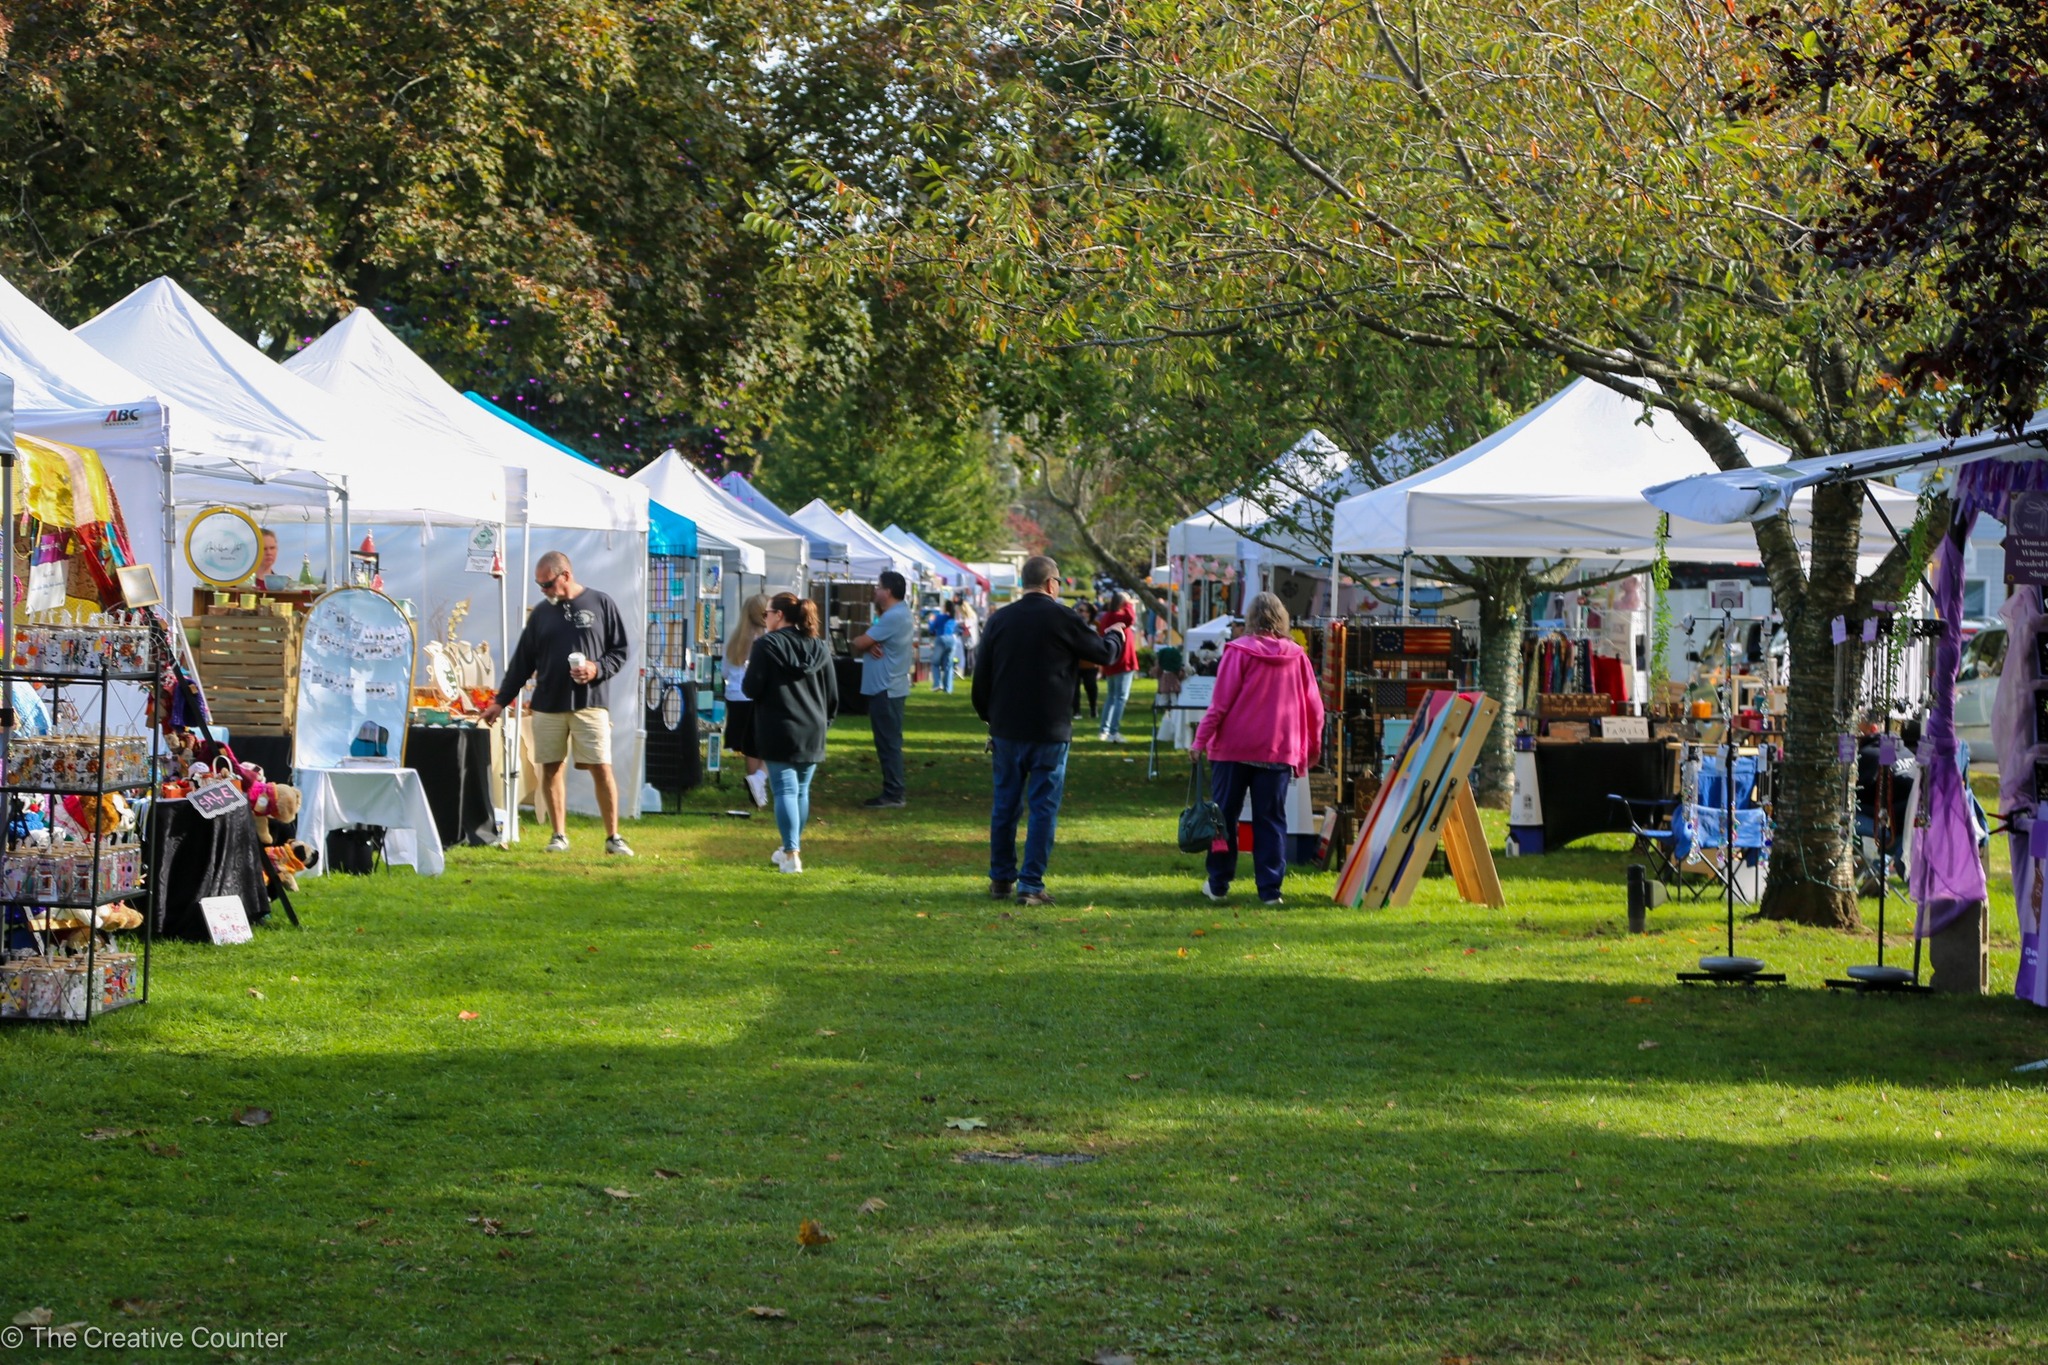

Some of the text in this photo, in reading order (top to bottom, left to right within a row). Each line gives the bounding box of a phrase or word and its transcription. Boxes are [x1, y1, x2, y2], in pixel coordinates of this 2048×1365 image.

[104, 408, 139, 423] ABC
[2021, 538, 2040, 546] Mom
[2015, 559, 2044, 567] Beaded
[1606, 727, 1645, 736] FAMILY
[198, 787, 235, 810] SALE
